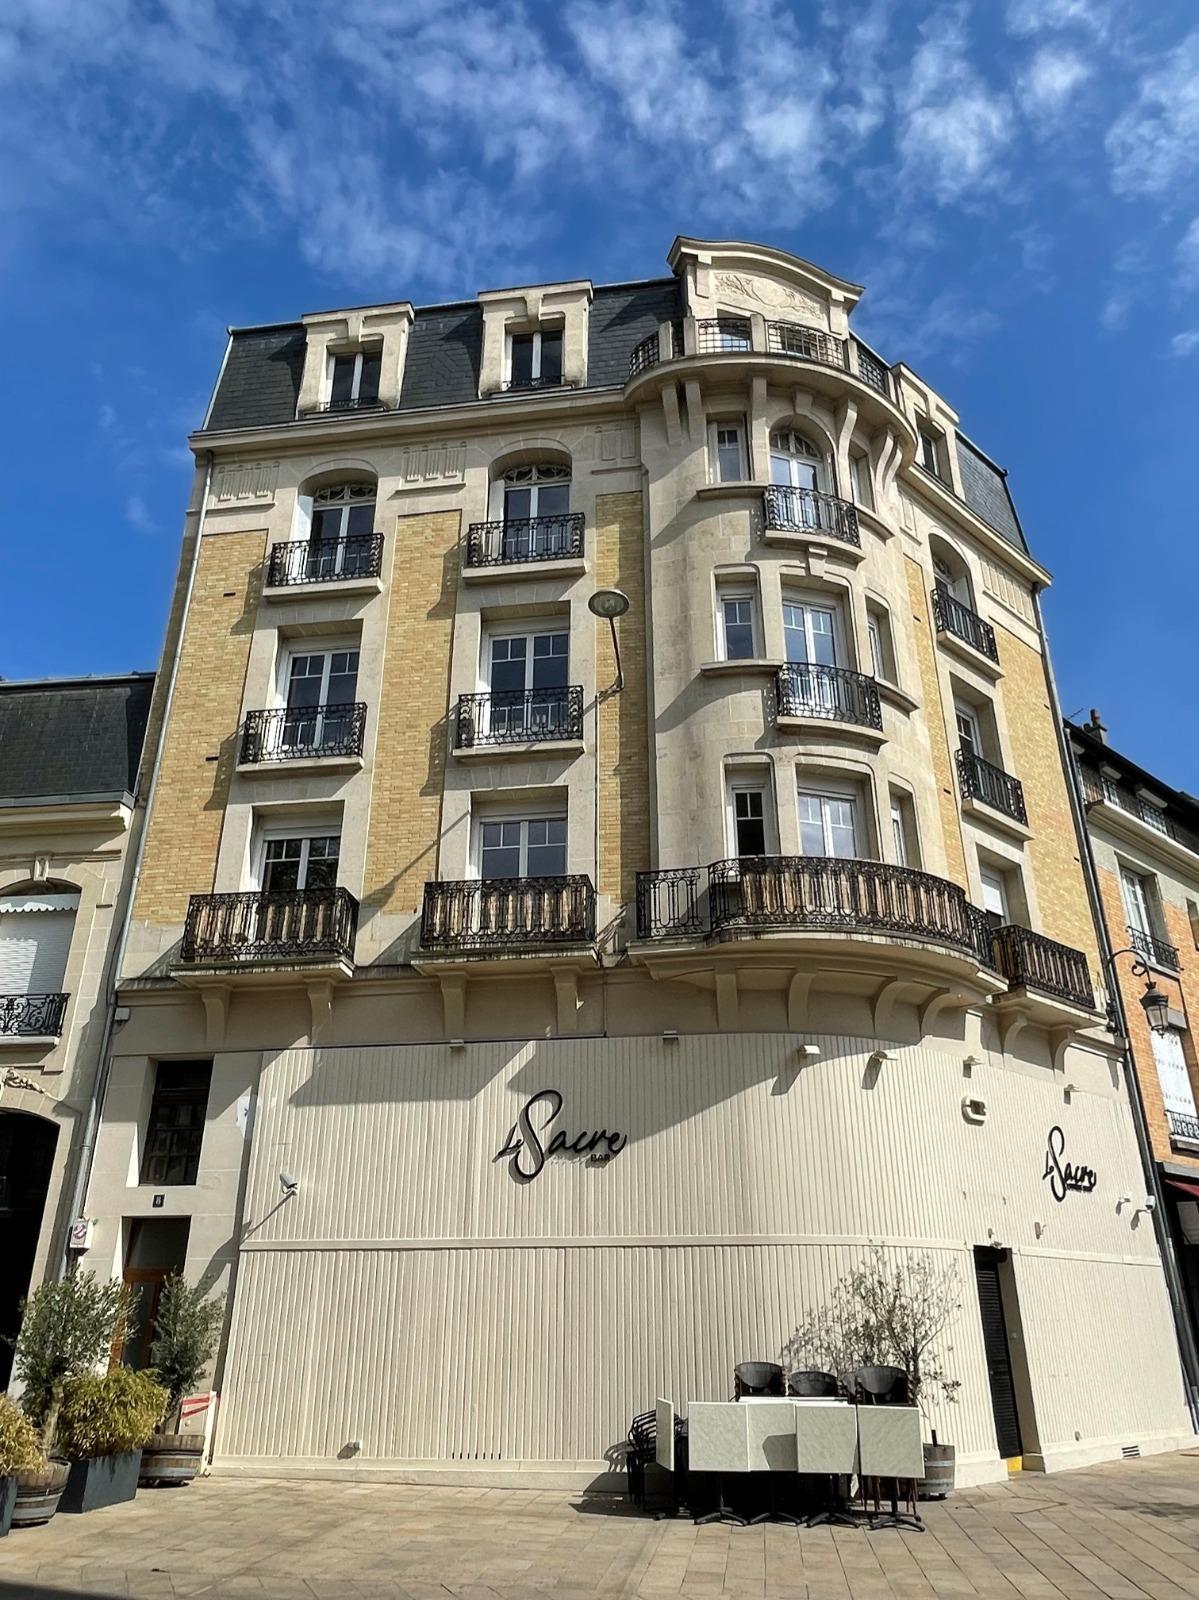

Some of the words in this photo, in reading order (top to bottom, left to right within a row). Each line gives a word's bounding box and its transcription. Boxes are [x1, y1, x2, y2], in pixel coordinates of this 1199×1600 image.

[493, 1121, 525, 1163] Le
[513, 1089, 628, 1180] Sacre
[590, 1153, 611, 1162] BAR
[1048, 1126, 1097, 1202] Sacre
